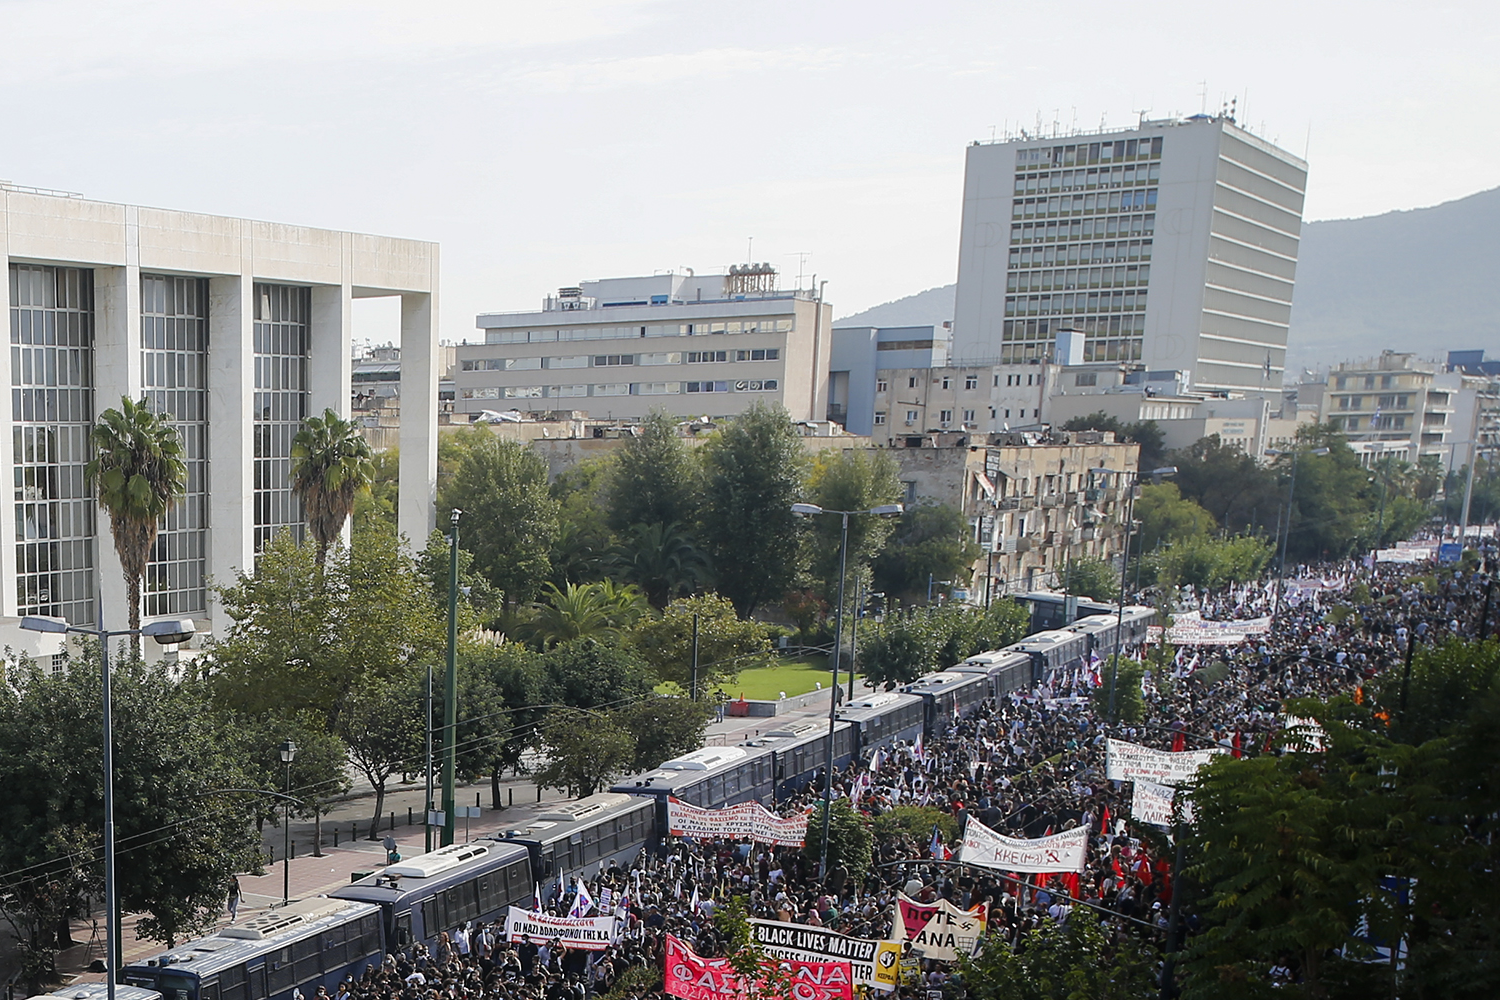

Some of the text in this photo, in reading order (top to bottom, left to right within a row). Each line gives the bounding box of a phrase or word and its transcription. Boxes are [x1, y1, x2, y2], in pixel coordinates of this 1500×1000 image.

[682, 831, 730, 839] ΣΥΝΔΙΚΤΟ
[994, 848, 1019, 864] ΚΚΕ
[907, 909, 957, 926] ΠΟΤΕ
[513, 922, 522, 932] ΟΙ
[522, 924, 539, 934] ΝΑΖΙ
[540, 927, 581, 939] ΔΟΛΟΦΟΝΟΙ
[583, 929, 596, 939] ΤΗΣ
[758, 926, 873, 959] BLACK LIVES MATTER
